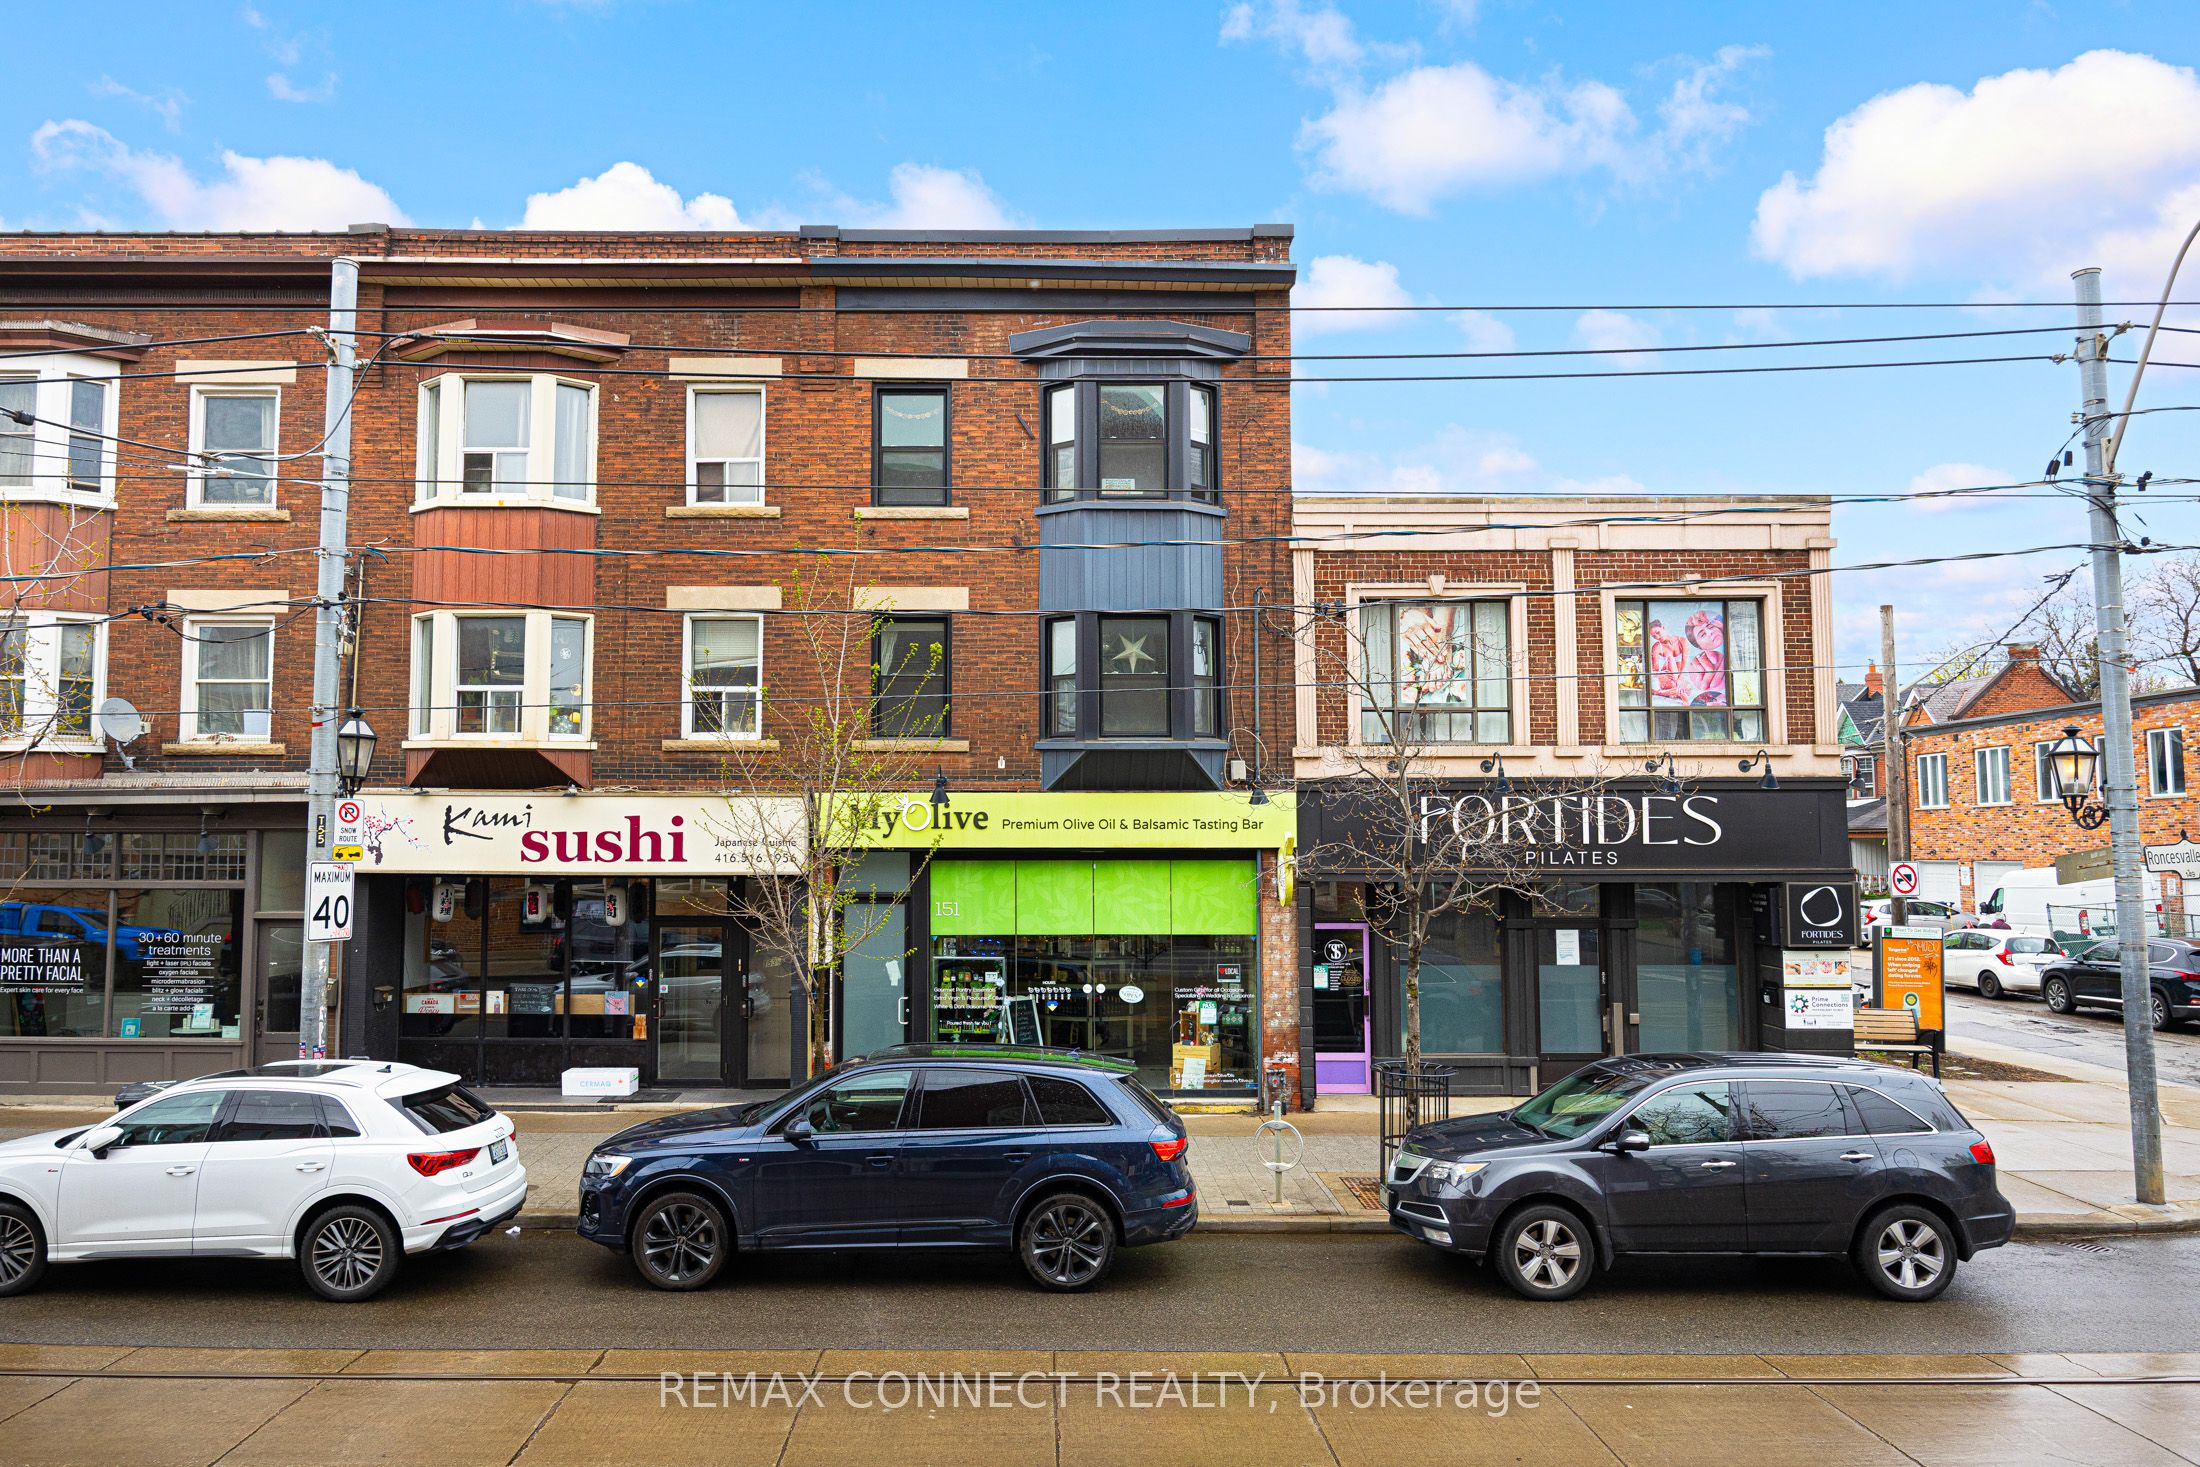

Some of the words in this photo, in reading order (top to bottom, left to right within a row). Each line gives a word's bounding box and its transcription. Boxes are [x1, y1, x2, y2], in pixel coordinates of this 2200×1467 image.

[442, 803, 533, 845] Kami
[1002, 818, 1059, 830] Premium
[1063, 818, 1095, 830] Olive
[1098, 818, 1116, 830] Oil
[1119, 819, 1128, 830] &
[1133, 818, 1189, 830] Balsamic
[1192, 818, 1238, 832] Tasting
[1242, 818, 1264, 830] Bar
[1420, 795, 1722, 845] FORTIDES
[520, 815, 688, 862] sushi
[715, 836, 758, 847] Japanese
[1525, 851, 1619, 865] PILATES
[2147, 849, 2200, 865] Roncesvalle
[314, 872, 351, 883] MAXIMUM
[312, 895, 350, 929] 40
[935, 902, 960, 917] 151
[182, 933, 222, 943] minute
[1801, 930, 1844, 939] FORTIDES
[1, 948, 35, 963] MORE
[37, 948, 70, 963] THAN
[72, 948, 81, 963] A
[148, 945, 211, 956] treatments
[0, 965, 44, 981] PRETTY
[46, 965, 84, 981] FACIAL
[1224, 967, 1240, 975] LOCAL
